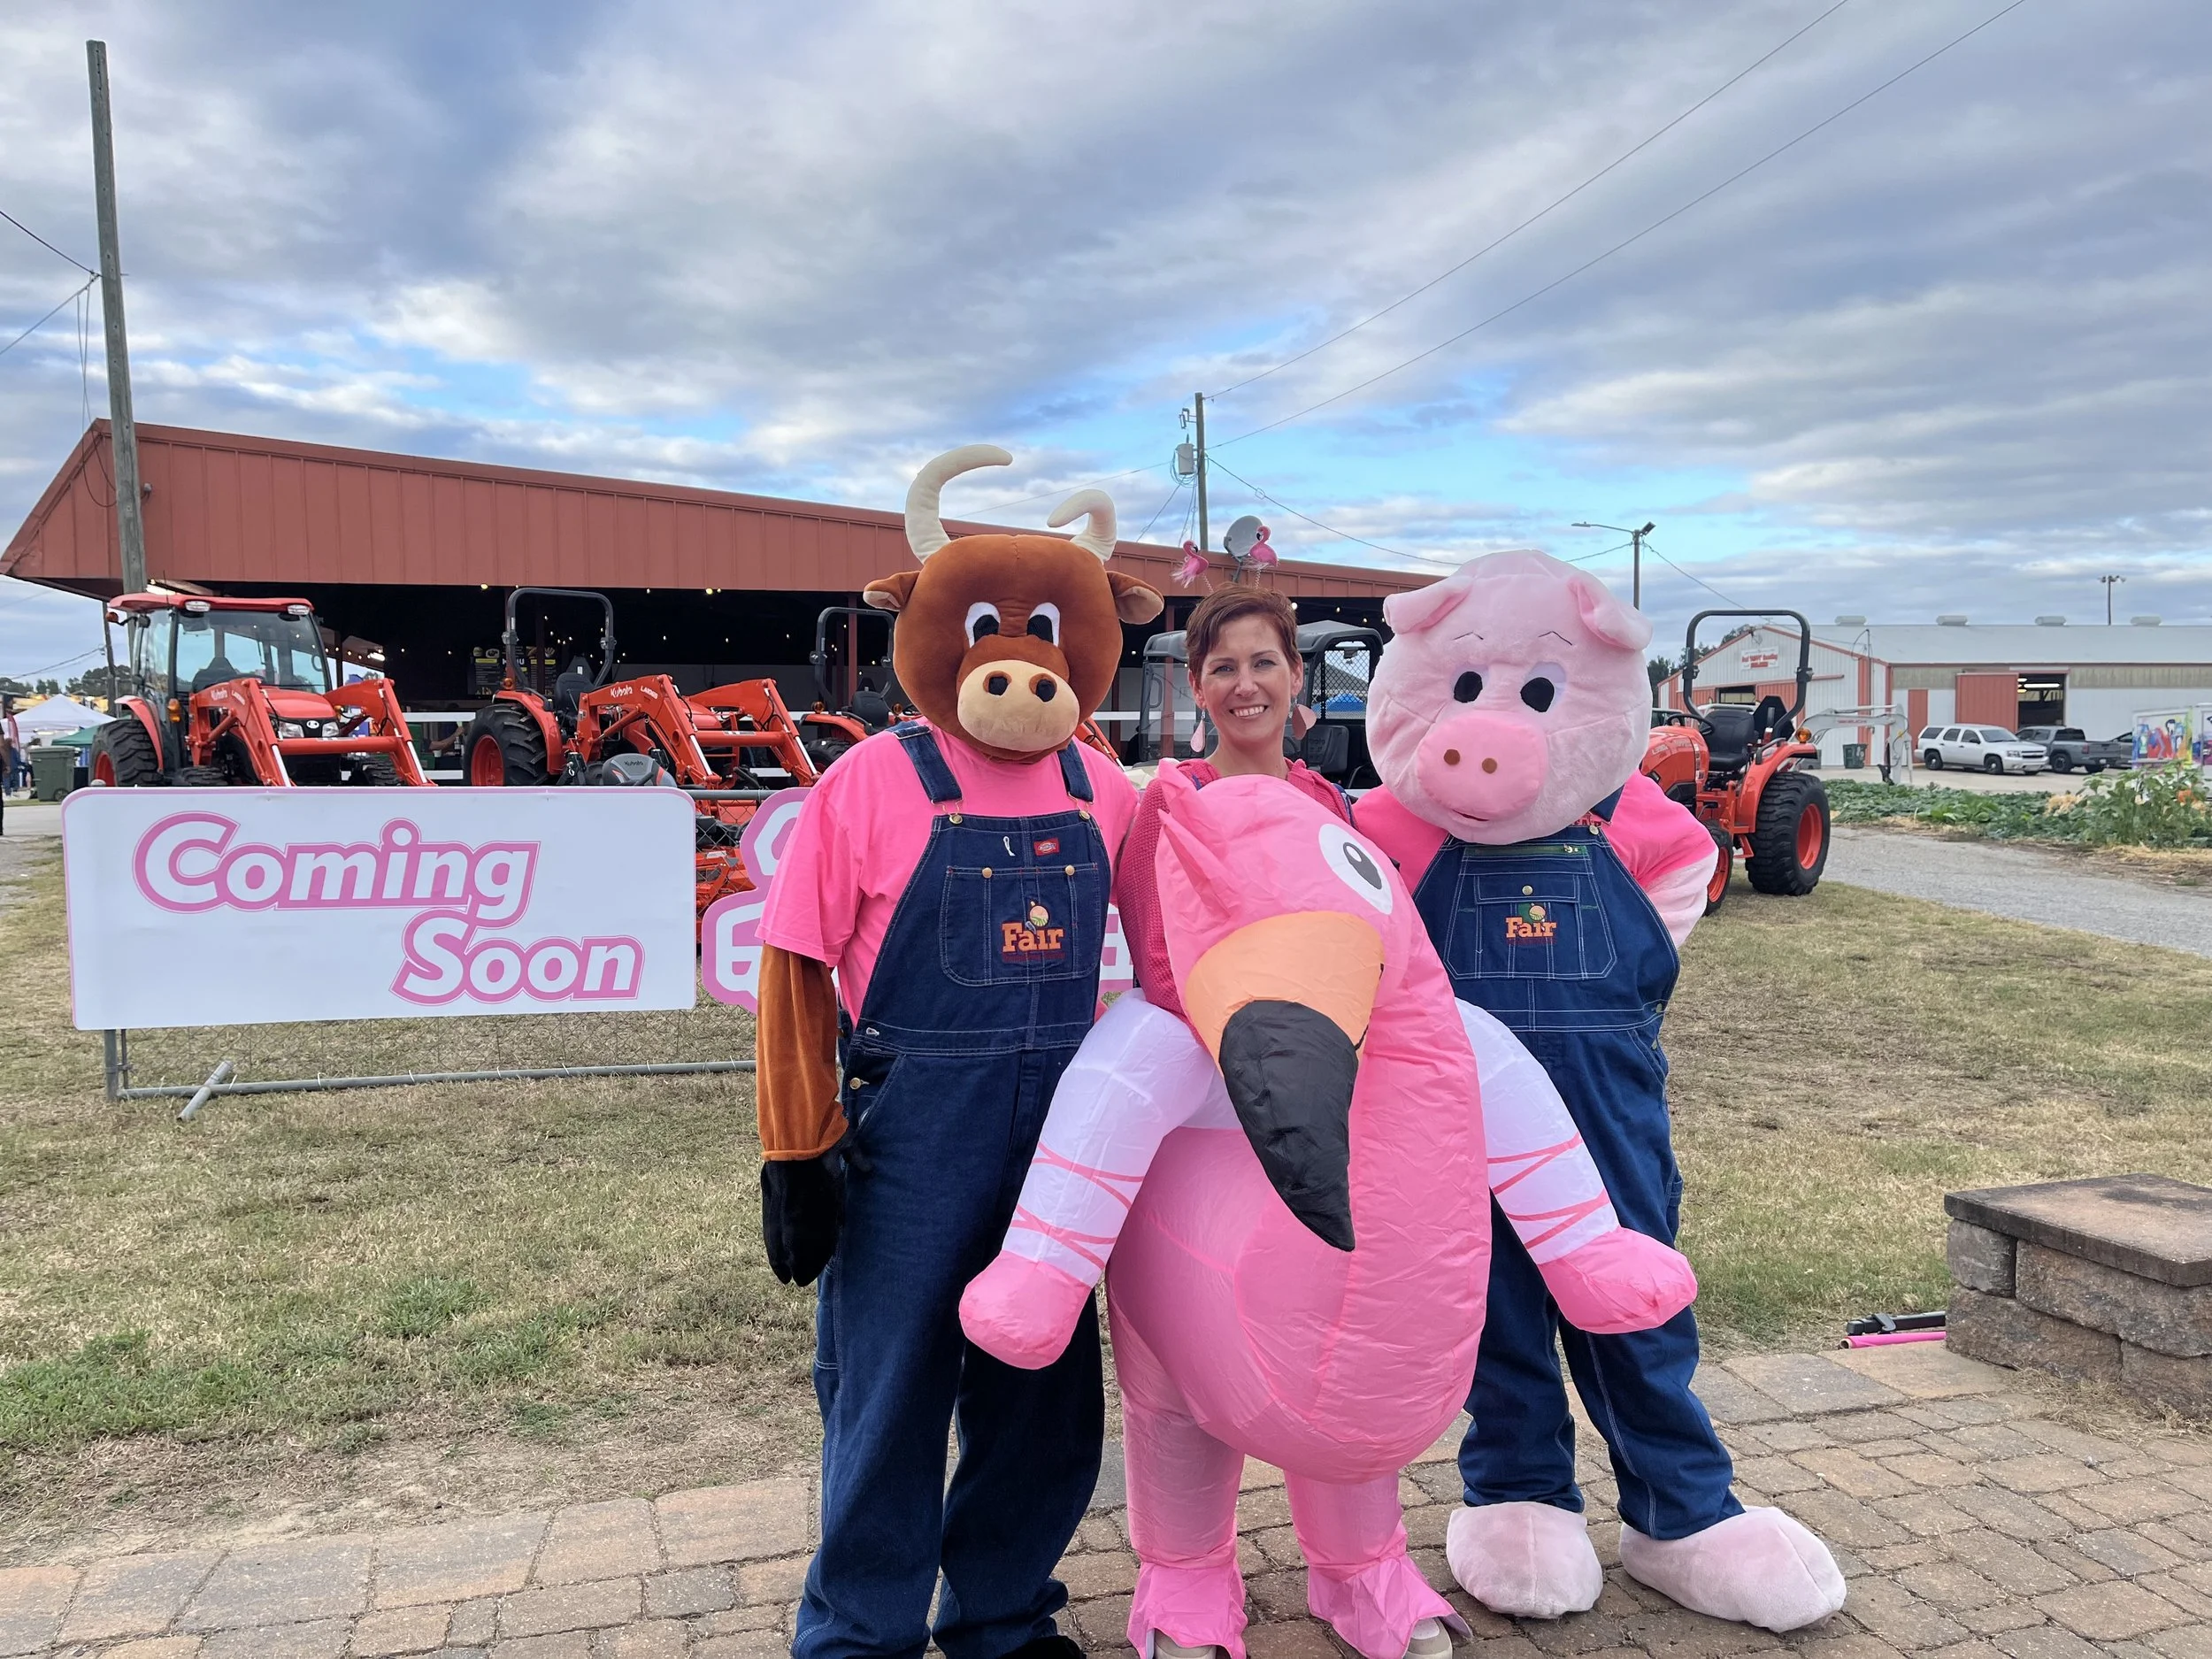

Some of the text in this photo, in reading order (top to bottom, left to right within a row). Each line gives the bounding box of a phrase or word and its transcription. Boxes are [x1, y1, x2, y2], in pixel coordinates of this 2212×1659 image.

[611, 685, 633, 698] Kubota
[133, 810, 540, 927] Coming
[1002, 919, 1064, 953] Fair
[1506, 915, 1557, 938] Fair
[389, 909, 644, 1004] Soon
